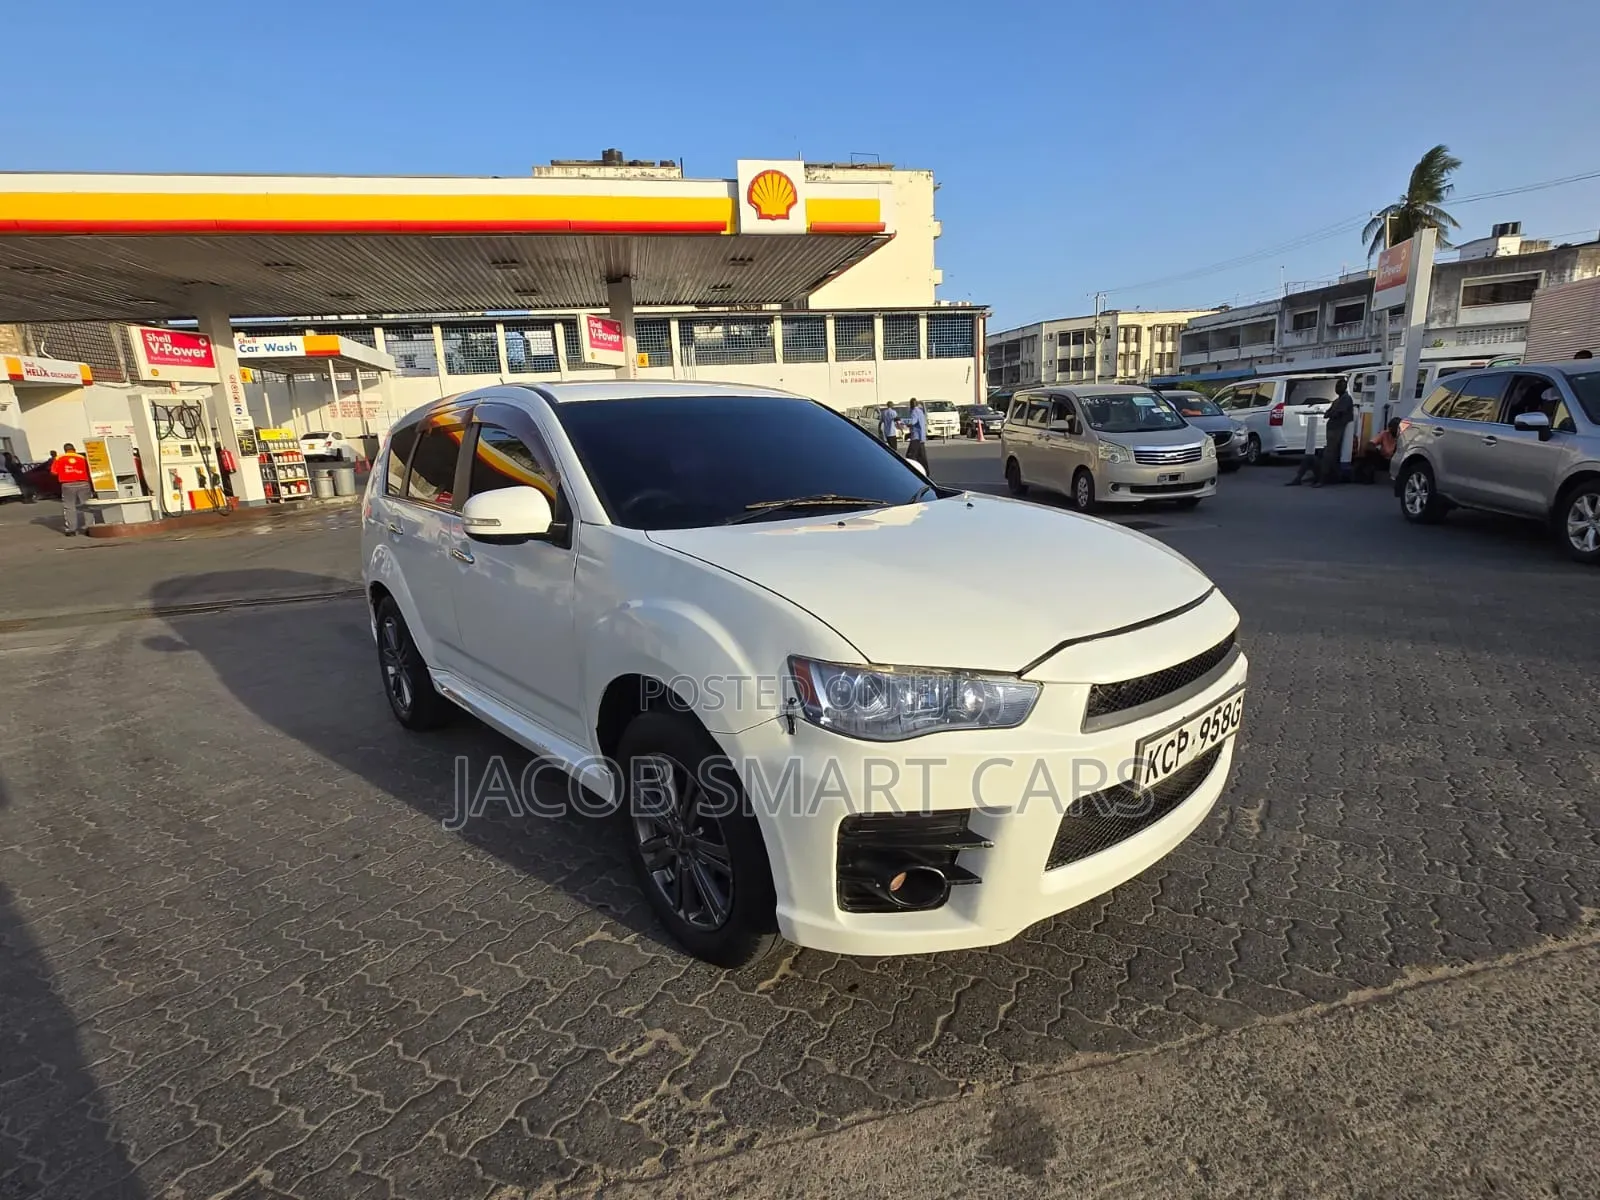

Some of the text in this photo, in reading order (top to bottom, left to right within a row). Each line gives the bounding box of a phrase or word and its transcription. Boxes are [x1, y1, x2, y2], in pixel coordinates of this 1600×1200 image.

[146, 333, 172, 343] Shell
[238, 336, 257, 344] Shell
[590, 327, 620, 343] V-Power
[148, 341, 207, 358] V-Power
[239, 342, 298, 353] Car Wash
[25, 367, 50, 378] HELIX
[1145, 696, 1242, 785] KCP 958G
